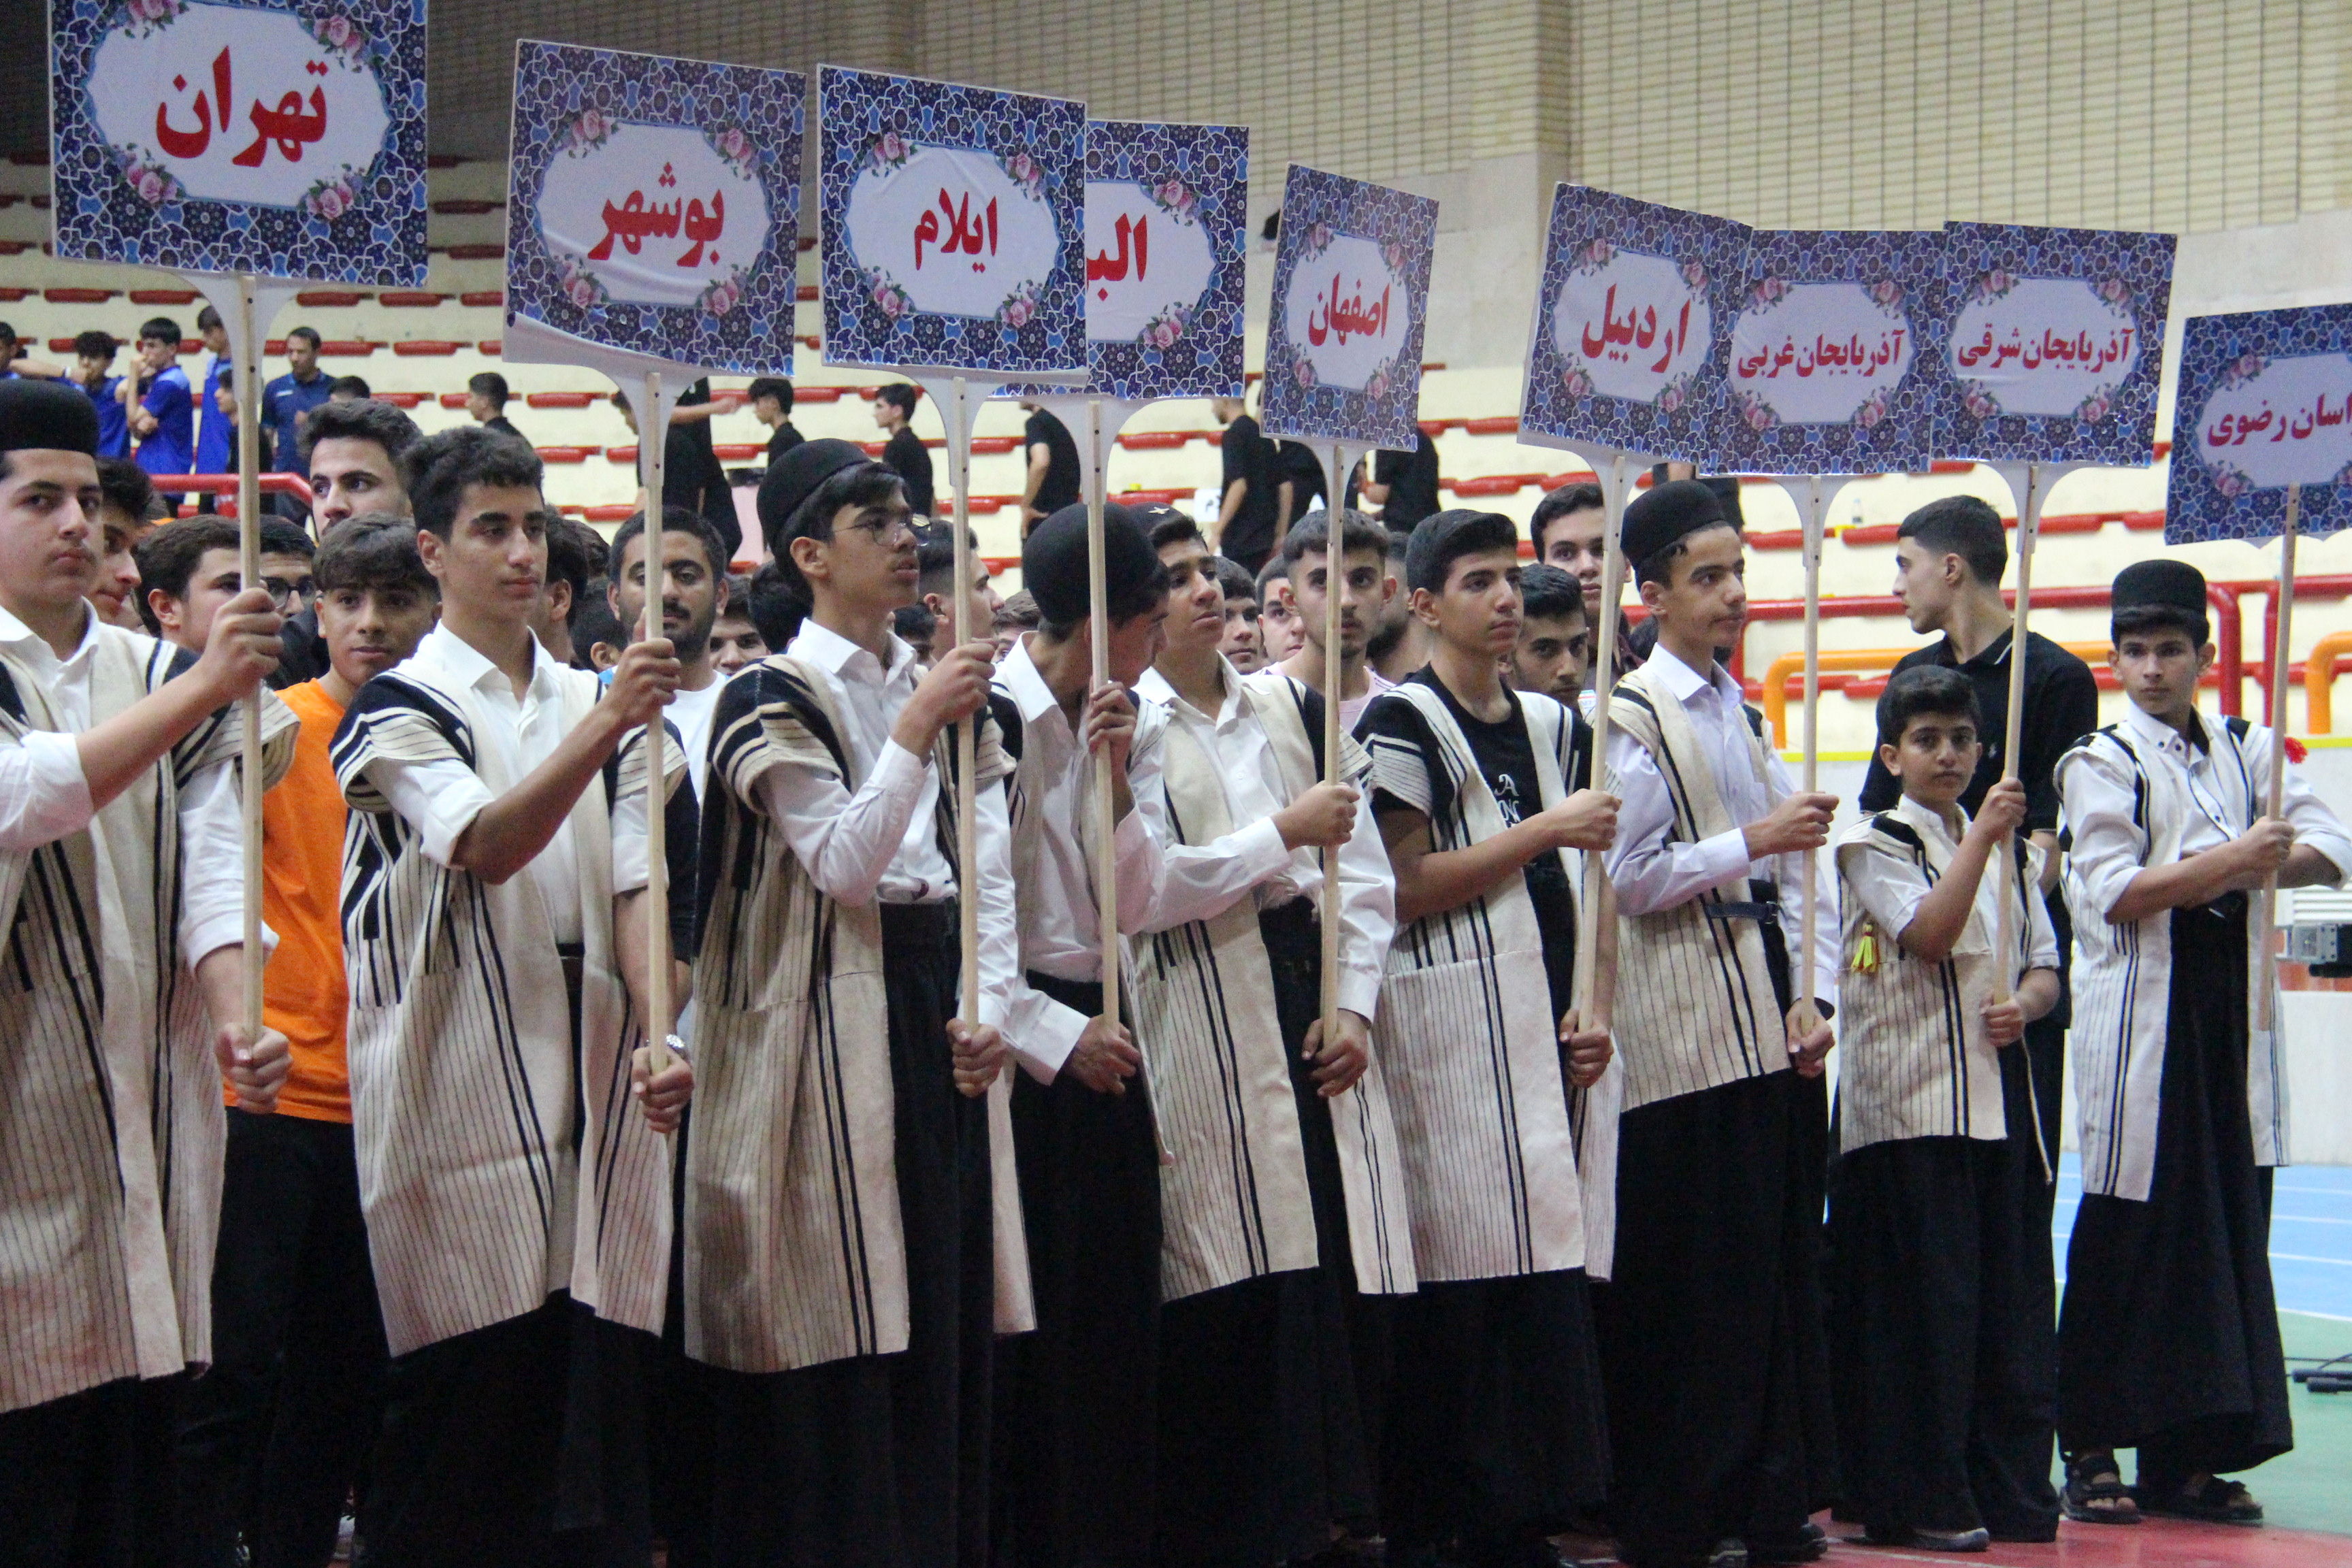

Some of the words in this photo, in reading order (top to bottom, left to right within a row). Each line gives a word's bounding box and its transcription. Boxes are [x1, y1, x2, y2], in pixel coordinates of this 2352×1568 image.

[156, 46, 328, 167] تهران
[587, 161, 725, 267] بوشهر
[914, 187, 998, 274] ایلام
[1086, 212, 1148, 301] الب
[1308, 272, 1390, 347] اصفهان
[1581, 282, 1691, 374] اردبیل
[1737, 334, 1795, 378] غربی
[1796, 329, 1906, 378] آذربایجان
[1958, 323, 2021, 368] شرقی
[2022, 327, 2135, 373] آذربایجان
[2207, 399, 2287, 446] رضوی
[2291, 392, 2352, 440] اسان
